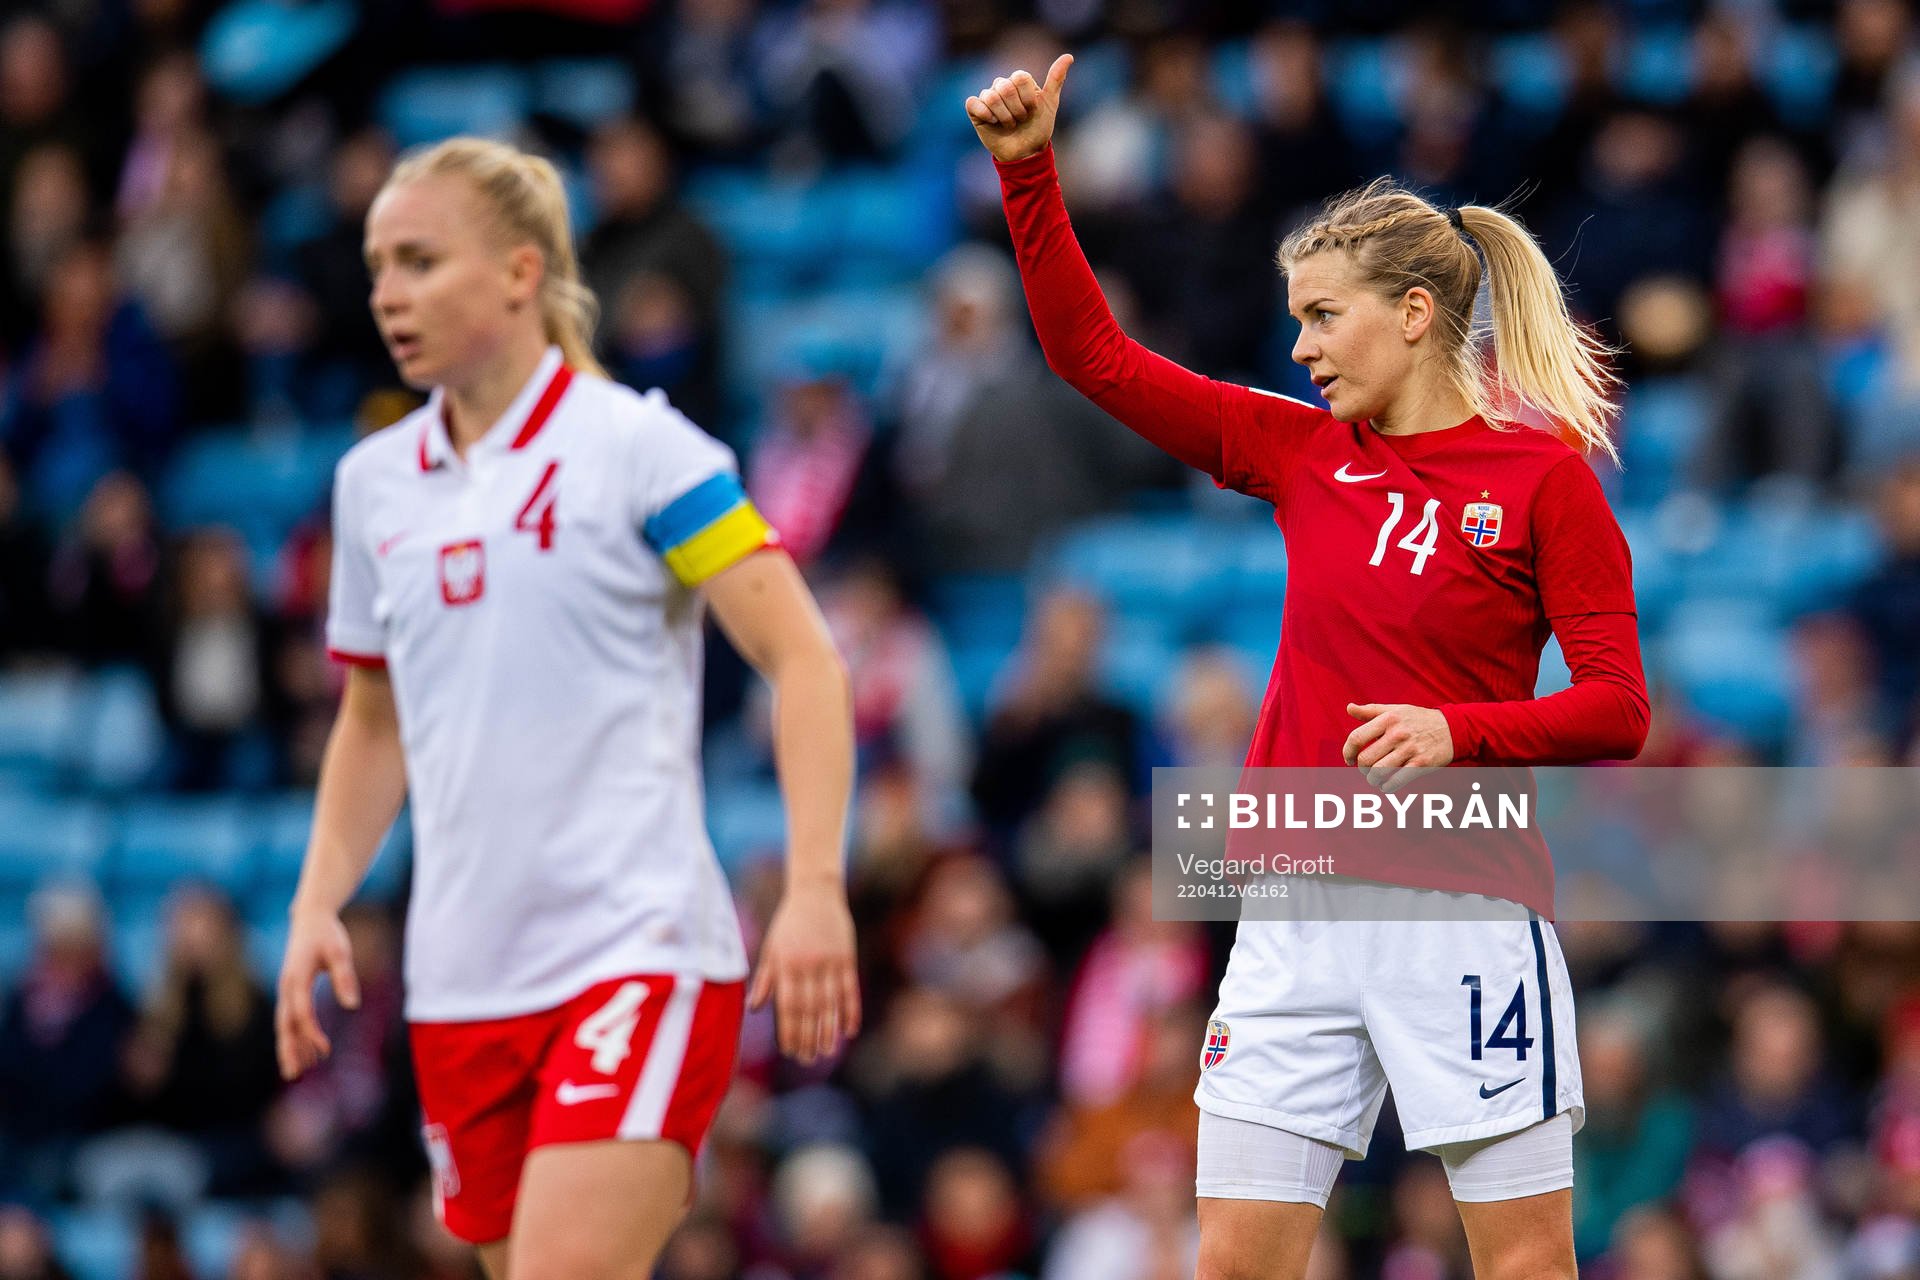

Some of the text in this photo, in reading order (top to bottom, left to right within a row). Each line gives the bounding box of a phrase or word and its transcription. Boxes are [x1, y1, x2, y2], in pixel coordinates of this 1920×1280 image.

[512, 461, 560, 552] 4
[1369, 492, 1441, 575] 14
[575, 981, 651, 1074] 4
[1461, 975, 1534, 1061] 14
